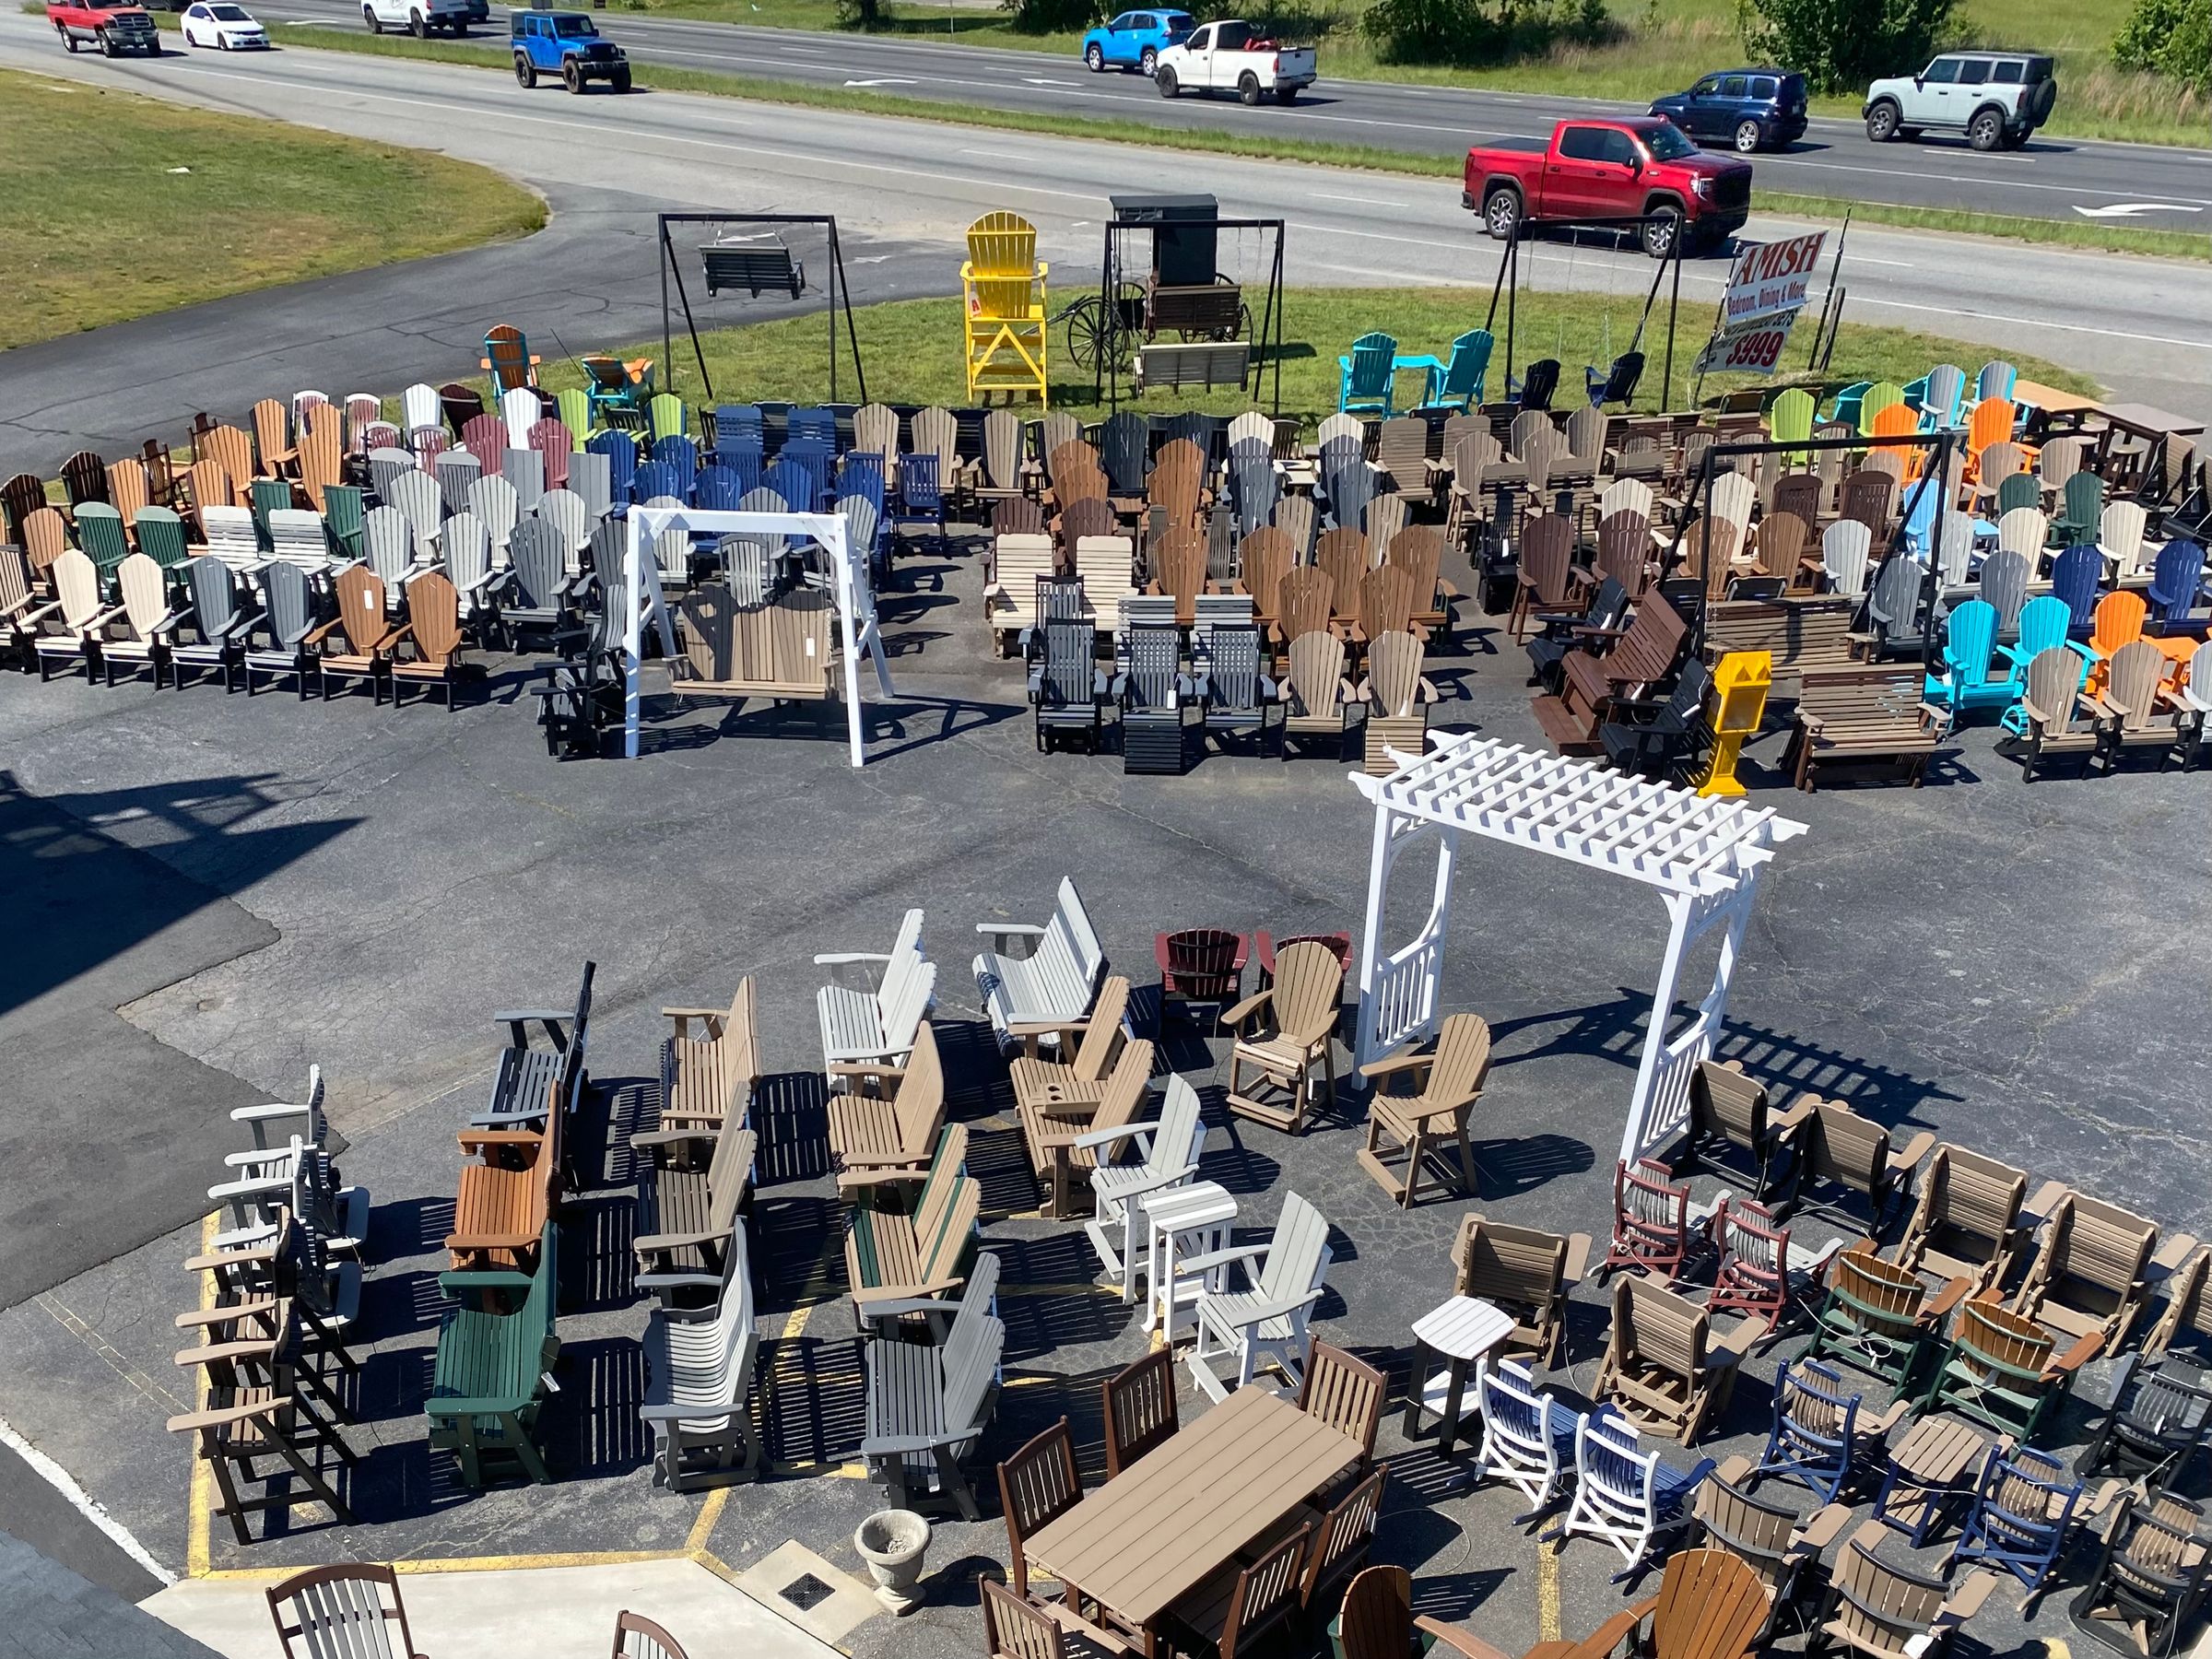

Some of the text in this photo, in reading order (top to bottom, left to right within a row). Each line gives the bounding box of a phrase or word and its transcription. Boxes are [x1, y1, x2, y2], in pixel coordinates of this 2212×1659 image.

[1730, 232, 1827, 288] AMISH
[1759, 286, 1780, 309] Dining
[1787, 281, 1806, 301] More
[1725, 331, 1784, 367] $999
